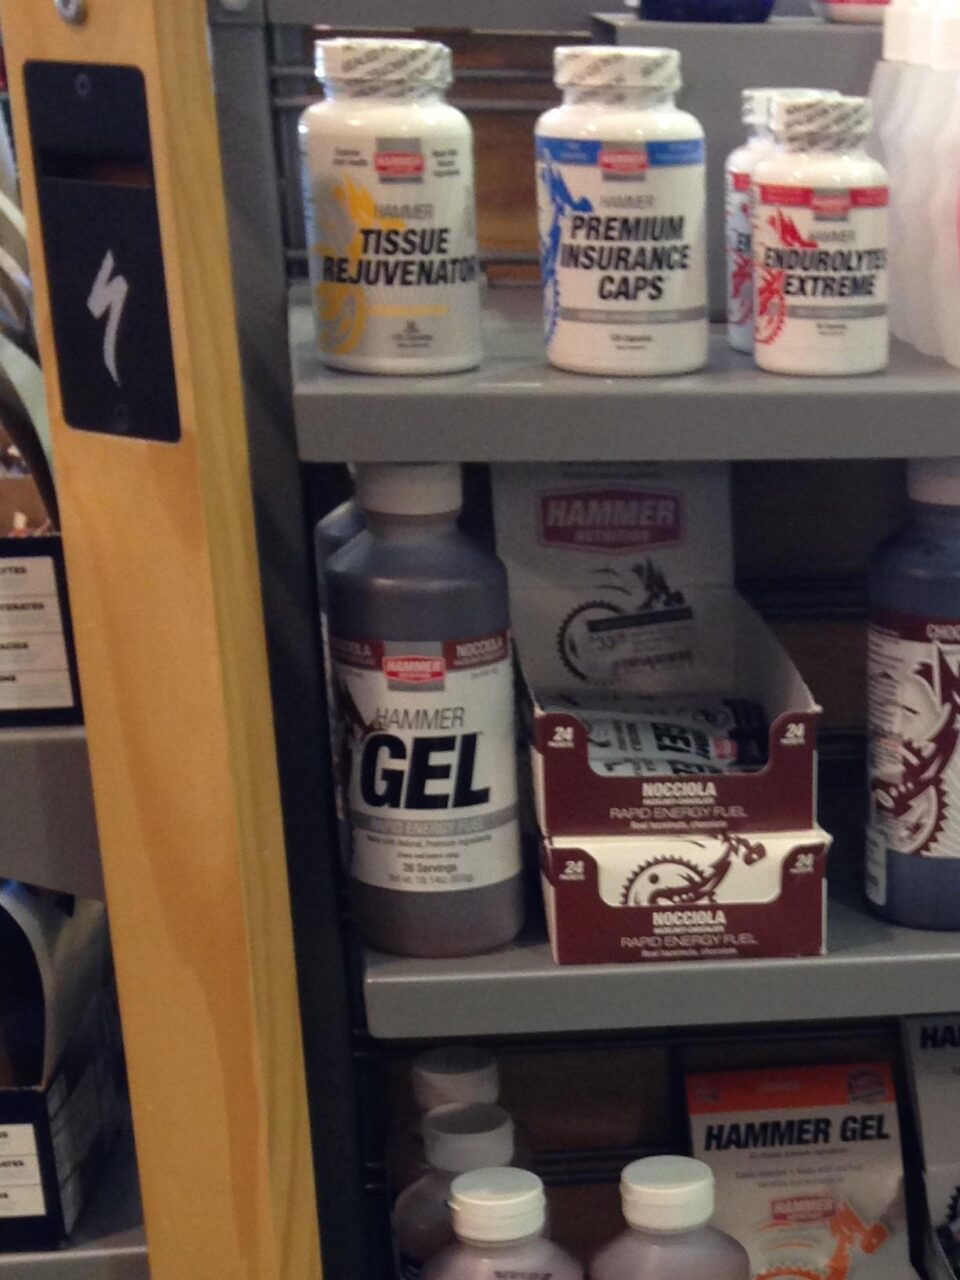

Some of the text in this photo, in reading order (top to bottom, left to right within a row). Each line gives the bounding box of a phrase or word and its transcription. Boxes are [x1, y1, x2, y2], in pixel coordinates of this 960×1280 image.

[570, 215, 685, 241] PREMIUM
[360, 228, 449, 255] TISSUE
[560, 244, 690, 271] INSURANCE
[598, 275, 665, 301] CAPS
[784, 274, 878, 297] EXTREME
[546, 498, 678, 528] HAMMER
[374, 706, 466, 730] HAMMER
[553, 726, 574, 740] 24
[785, 723, 805, 738] 24
[360, 732, 491, 810] GEL
[642, 782, 717, 797] NOCCIOLA
[610, 805, 748, 820] RAPID ENERGY FUEL
[564, 860, 584, 874] 24
[795, 853, 814, 867] 24
[652, 909, 727, 926] NOCCIOLA
[621, 933, 758, 949] RAPID ENERGY FUEL
[704, 1114, 890, 1151] HAMMER GEL
